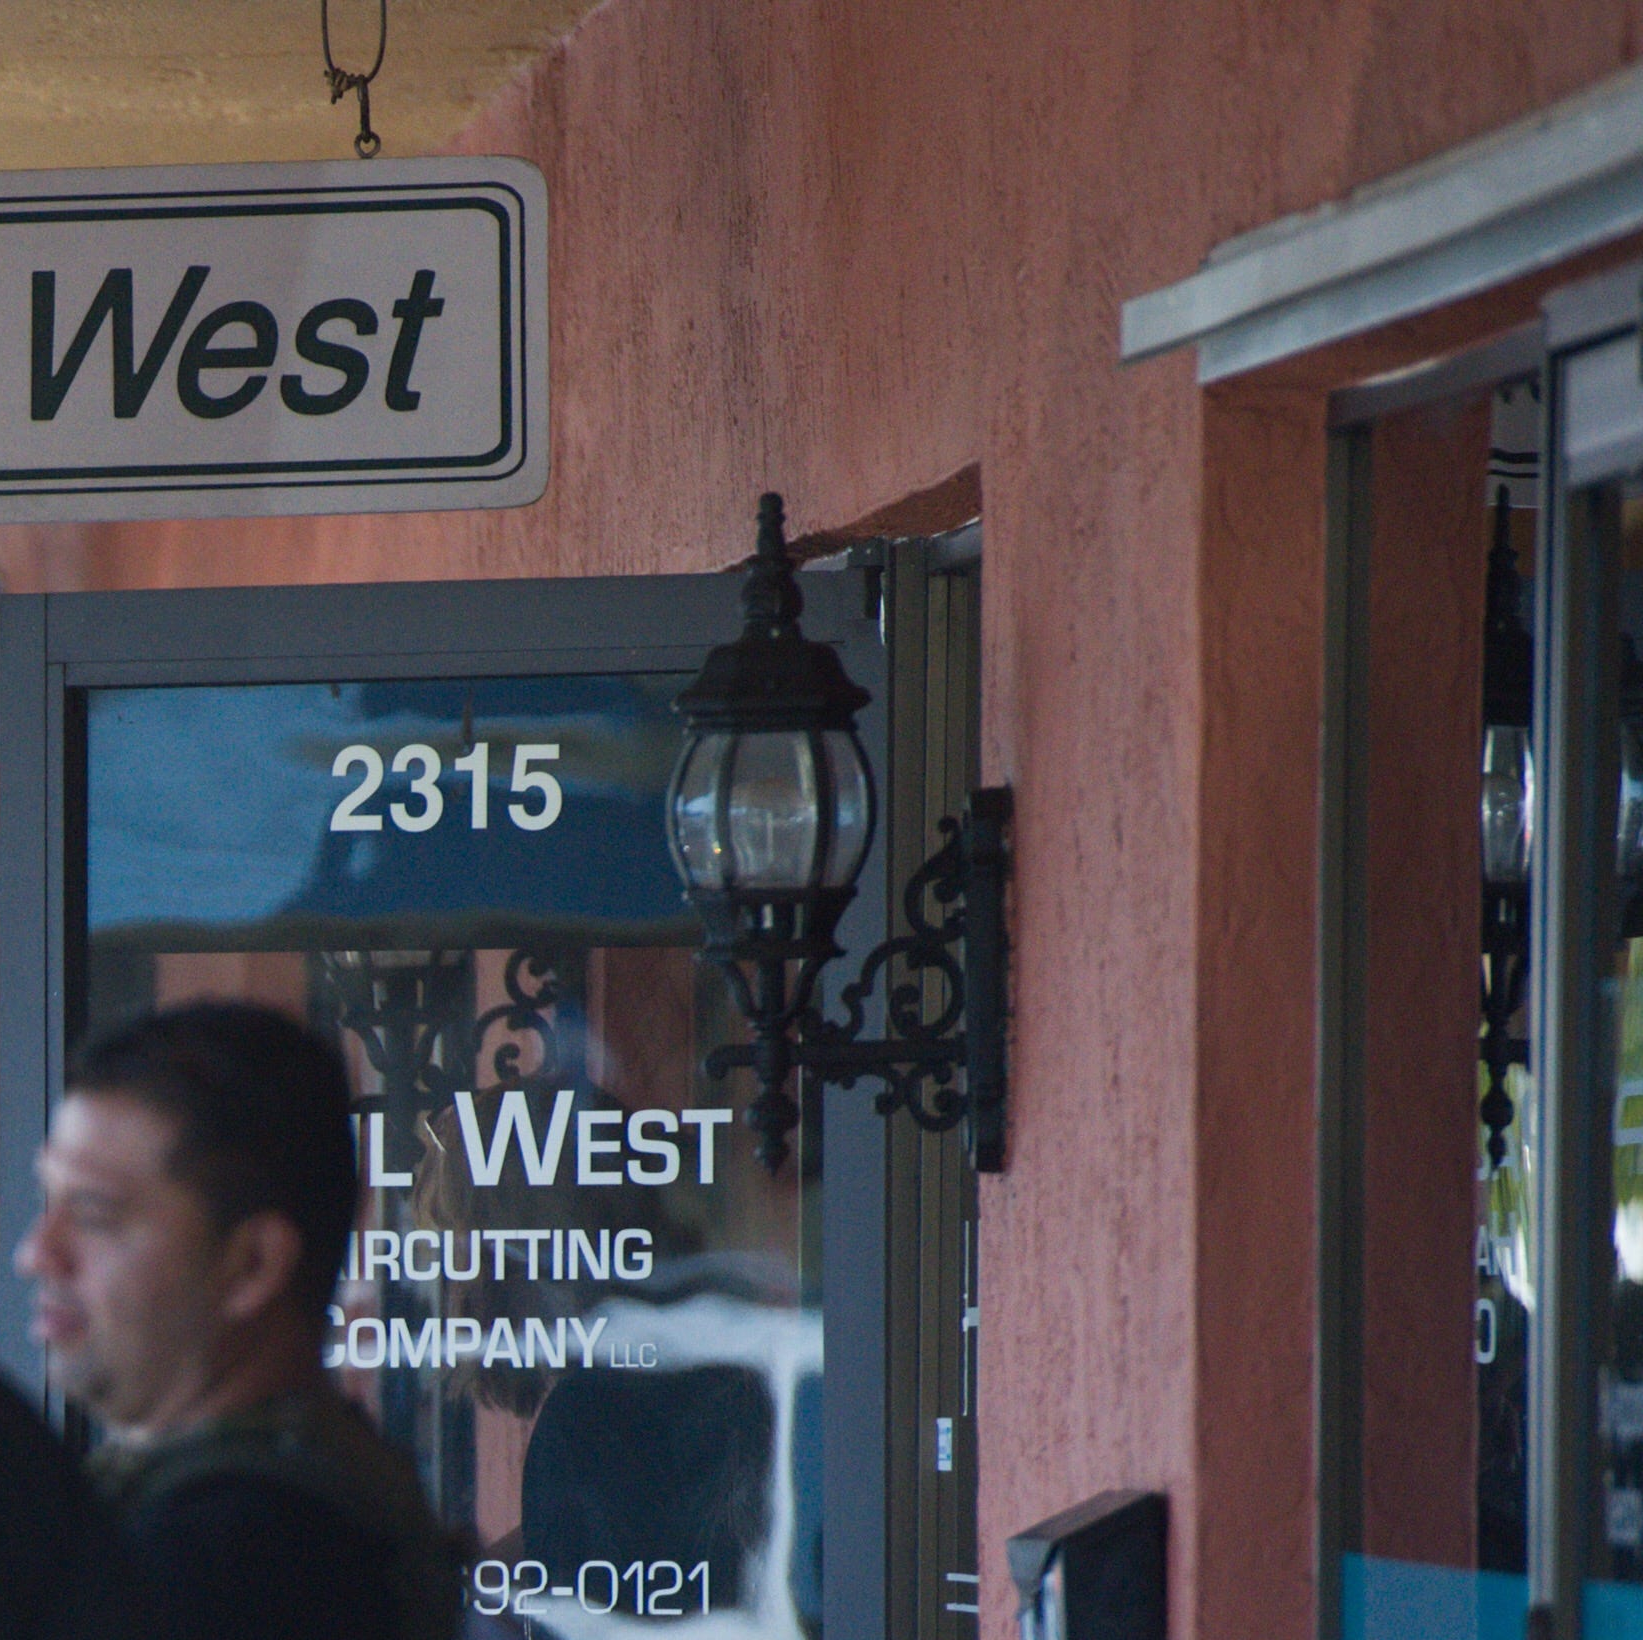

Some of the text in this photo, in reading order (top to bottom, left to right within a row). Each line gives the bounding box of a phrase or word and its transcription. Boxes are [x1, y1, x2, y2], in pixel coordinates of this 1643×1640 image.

[29, 265, 444, 421] West
[330, 742, 564, 832] 2315
[454, 1090, 733, 1187] WEST
[609, 1342, 658, 1369] LLC
[460, 1559, 711, 1615] 92-0121
